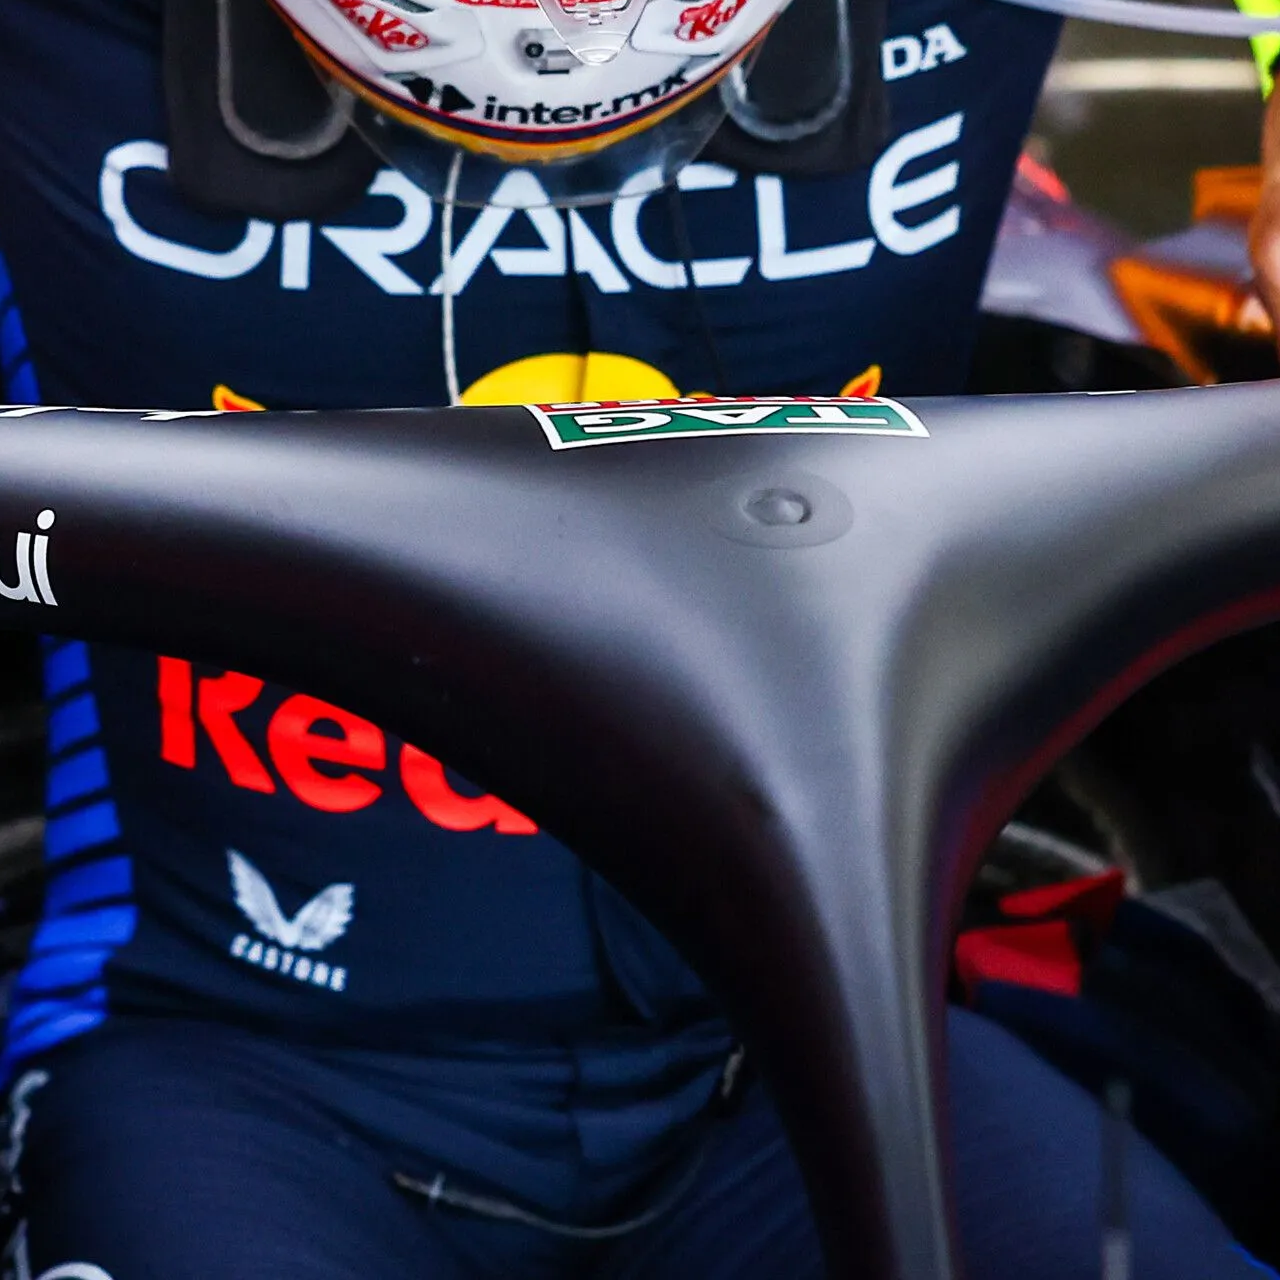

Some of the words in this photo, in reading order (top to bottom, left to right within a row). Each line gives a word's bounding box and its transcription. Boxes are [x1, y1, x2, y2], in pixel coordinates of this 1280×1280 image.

[483, 70, 692, 126] inter.mx
[100, 114, 963, 295] ORACLE
[573, 405, 891, 435] TAG
